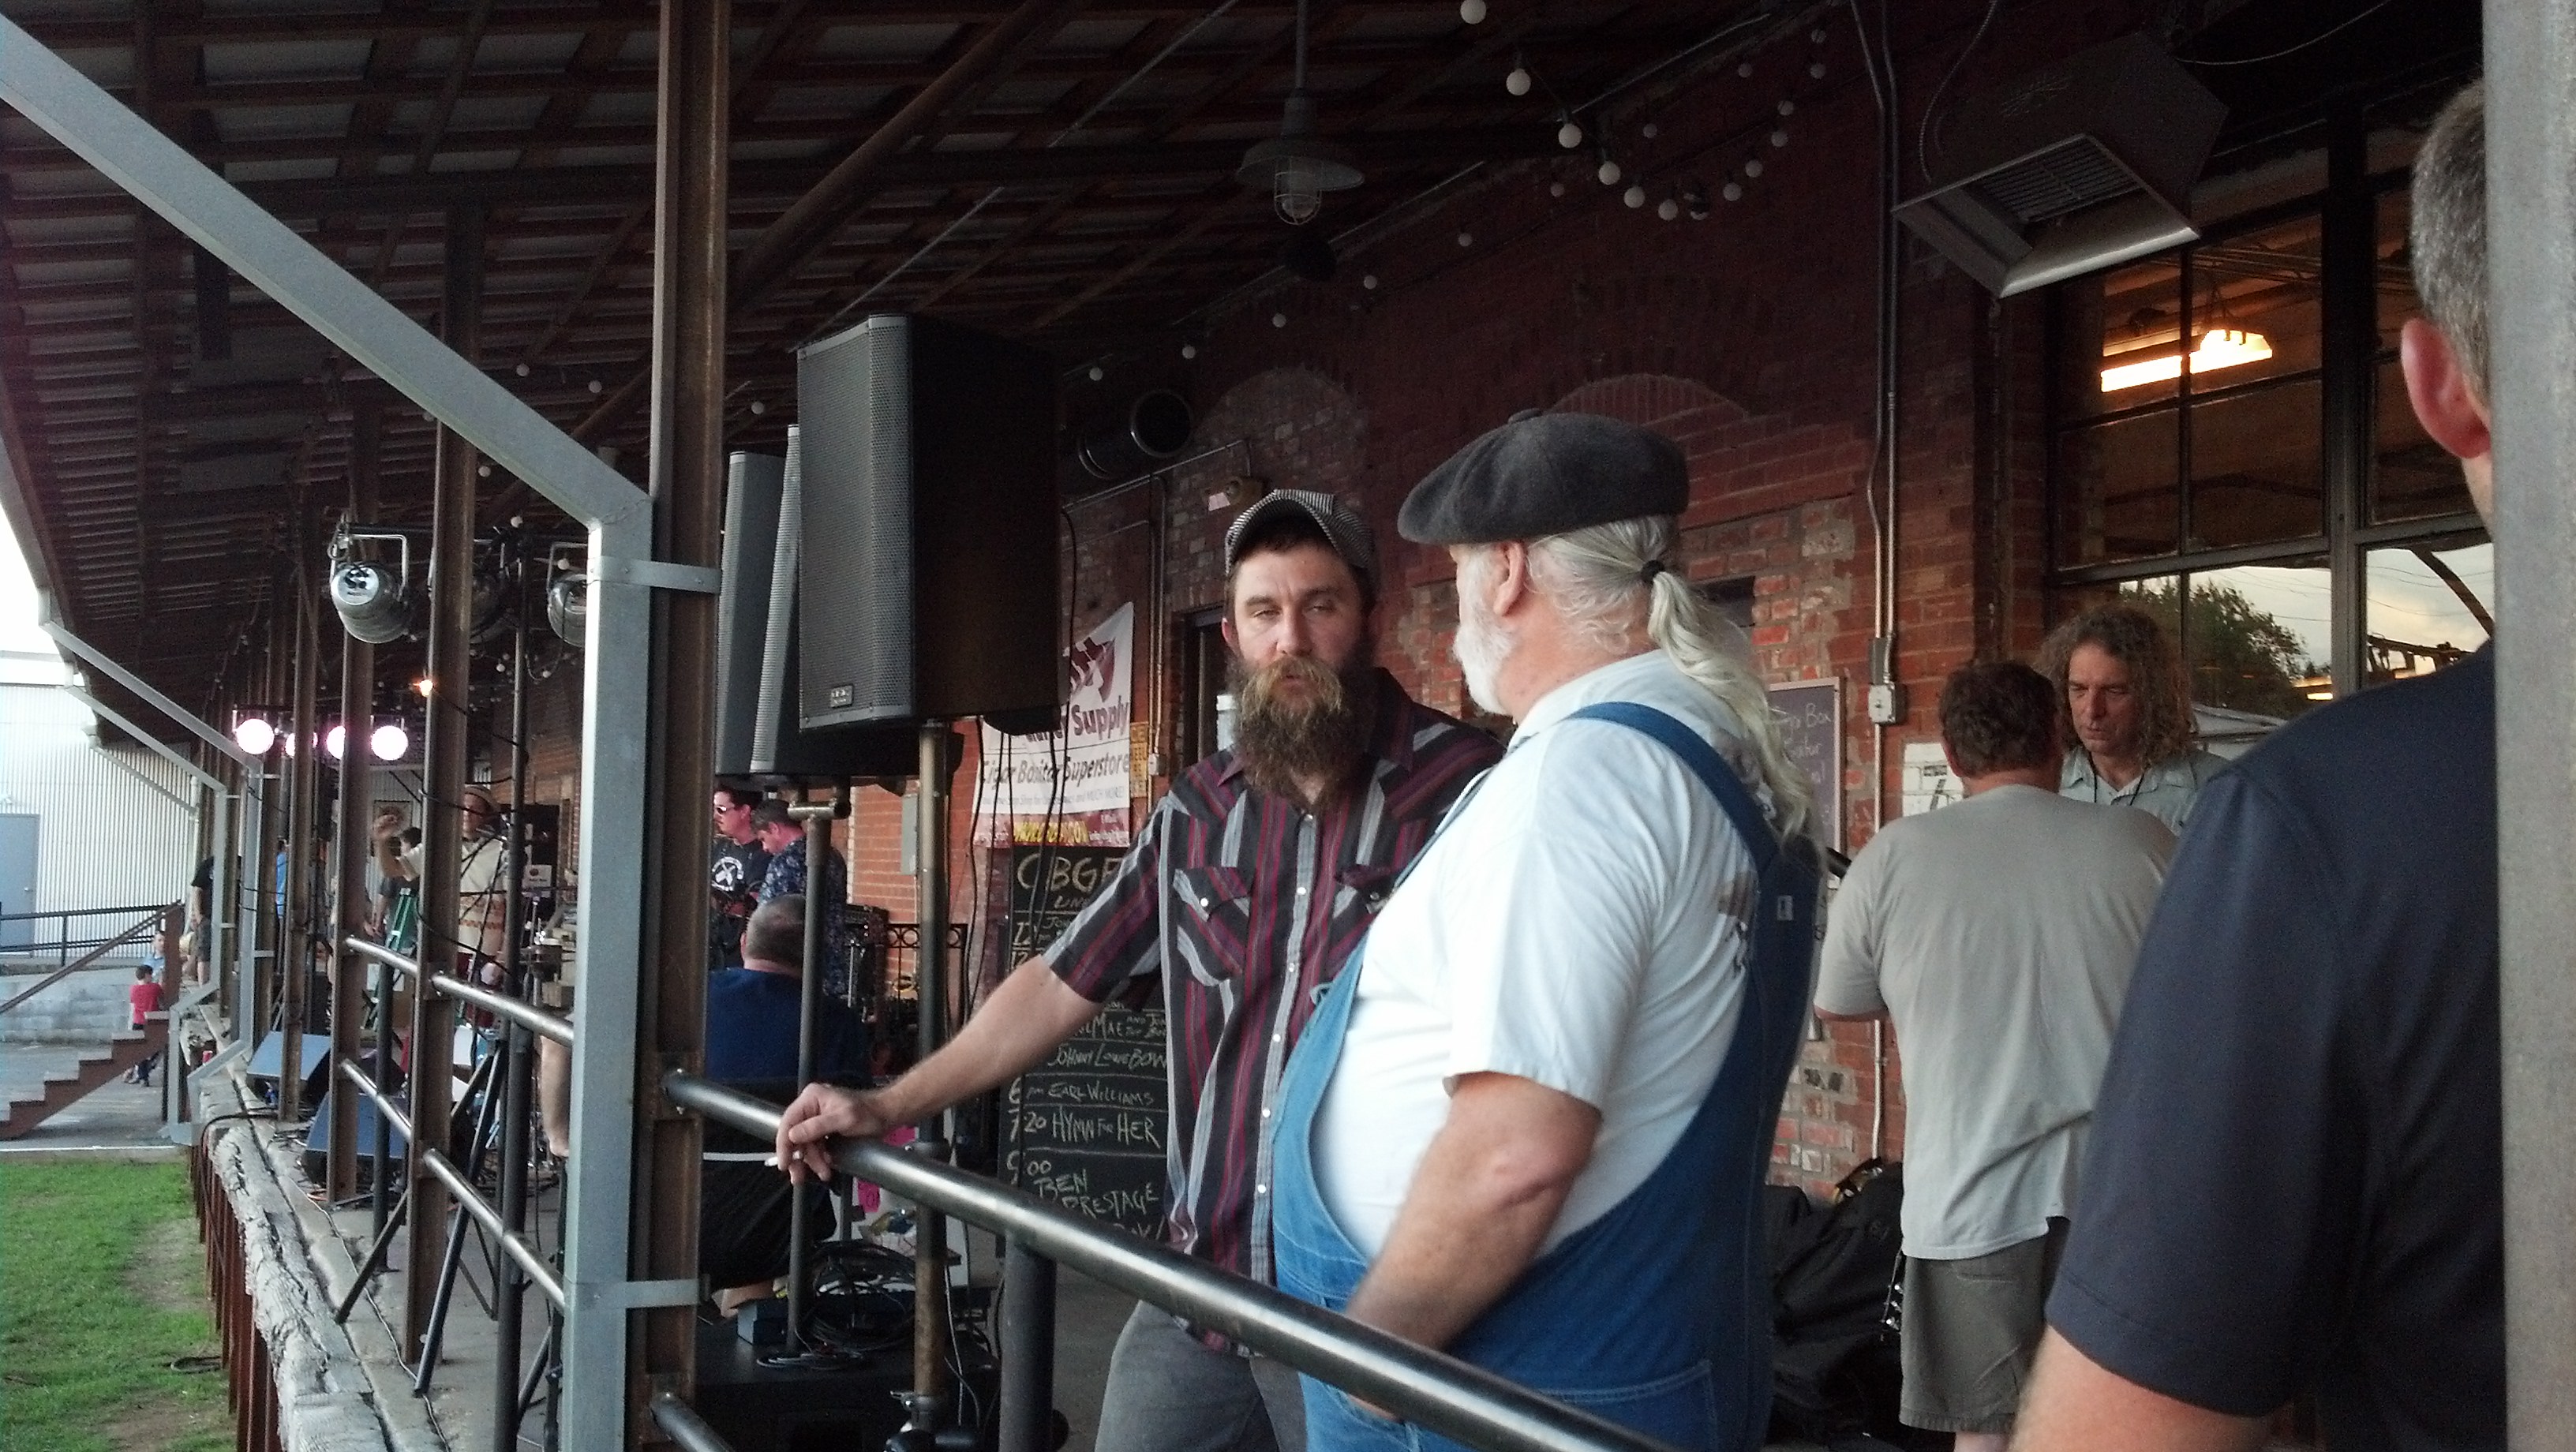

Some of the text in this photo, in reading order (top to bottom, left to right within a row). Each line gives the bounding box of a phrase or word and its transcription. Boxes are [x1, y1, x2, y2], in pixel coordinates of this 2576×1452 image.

[1071, 695, 1129, 741] Supply
[1065, 751, 1129, 788] Superstore
[1086, 1080, 1155, 1106] WILLIAMS
[1051, 1105, 1095, 1143] HYMN
[1117, 1111, 1161, 1149] HER
[1033, 1168, 1088, 1202] BEN
[1061, 1181, 1160, 1220] PRESTAGE
